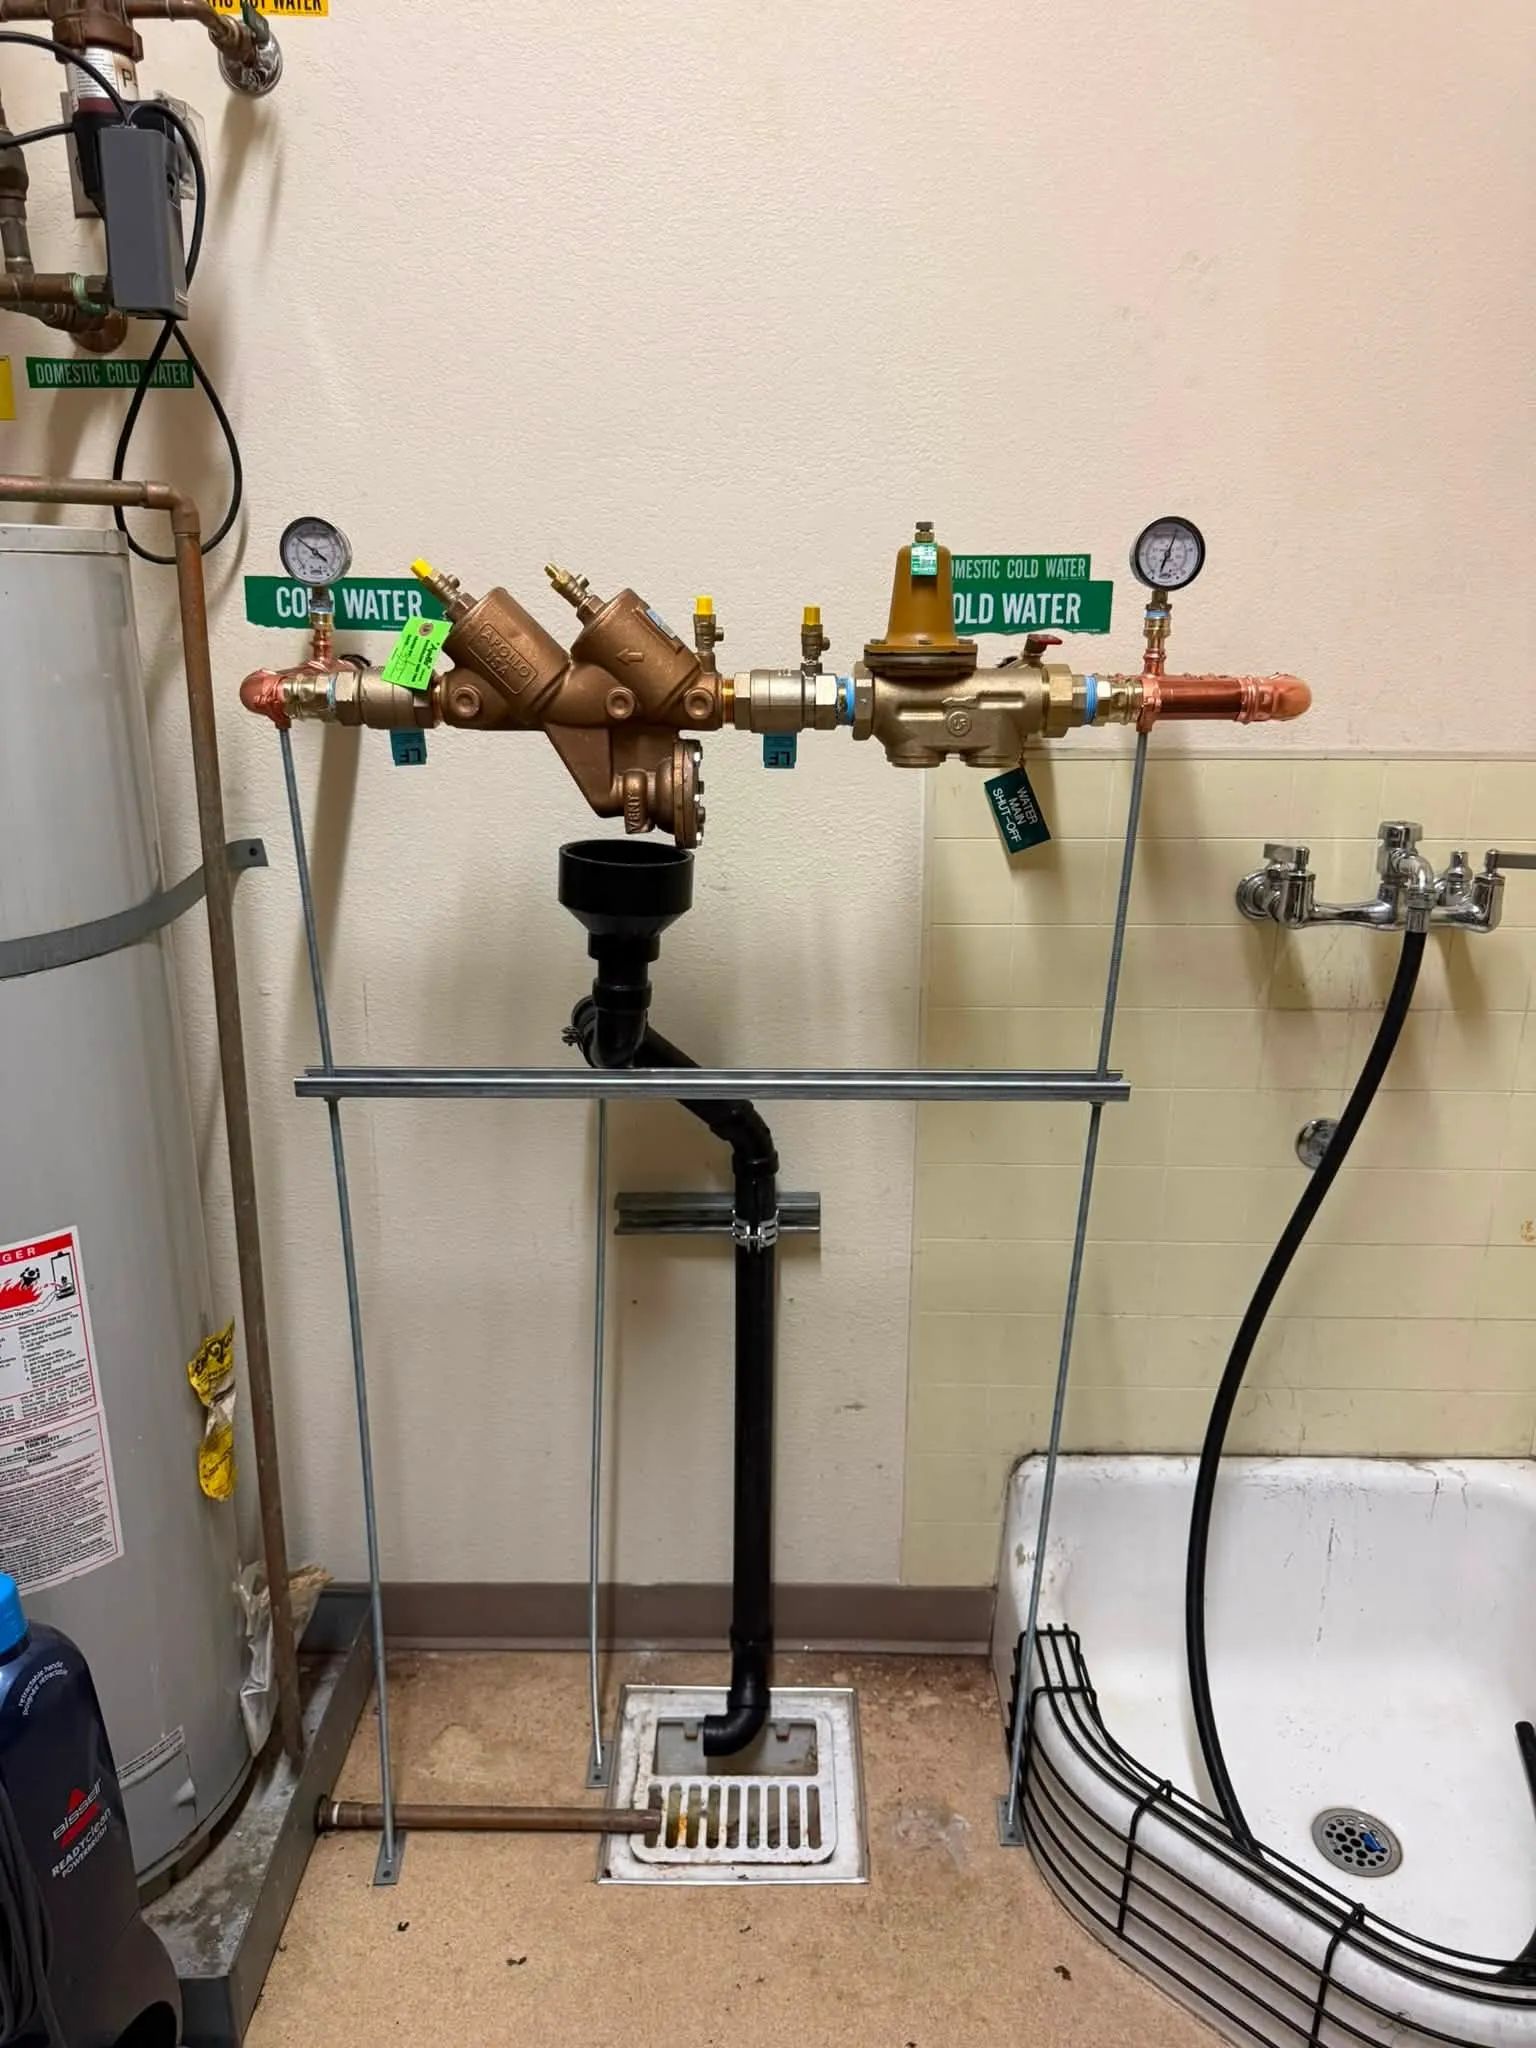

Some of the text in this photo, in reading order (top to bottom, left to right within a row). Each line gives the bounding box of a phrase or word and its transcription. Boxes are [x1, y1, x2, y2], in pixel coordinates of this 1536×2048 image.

[35, 363, 100, 384] DOMESTIC
[107, 363, 140, 384] COLD
[1007, 558, 1039, 579] COLD
[1045, 557, 1086, 578] WATER
[342, 587, 422, 621] WATER
[1002, 592, 1081, 624] WATER
[480, 629, 531, 678] APOLLO
[768, 751, 790, 766] LF
[992, 787, 1022, 842] SHUT-OFF
[1008, 797, 1026, 825] MAIN
[1017, 786, 1038, 825] WATER
